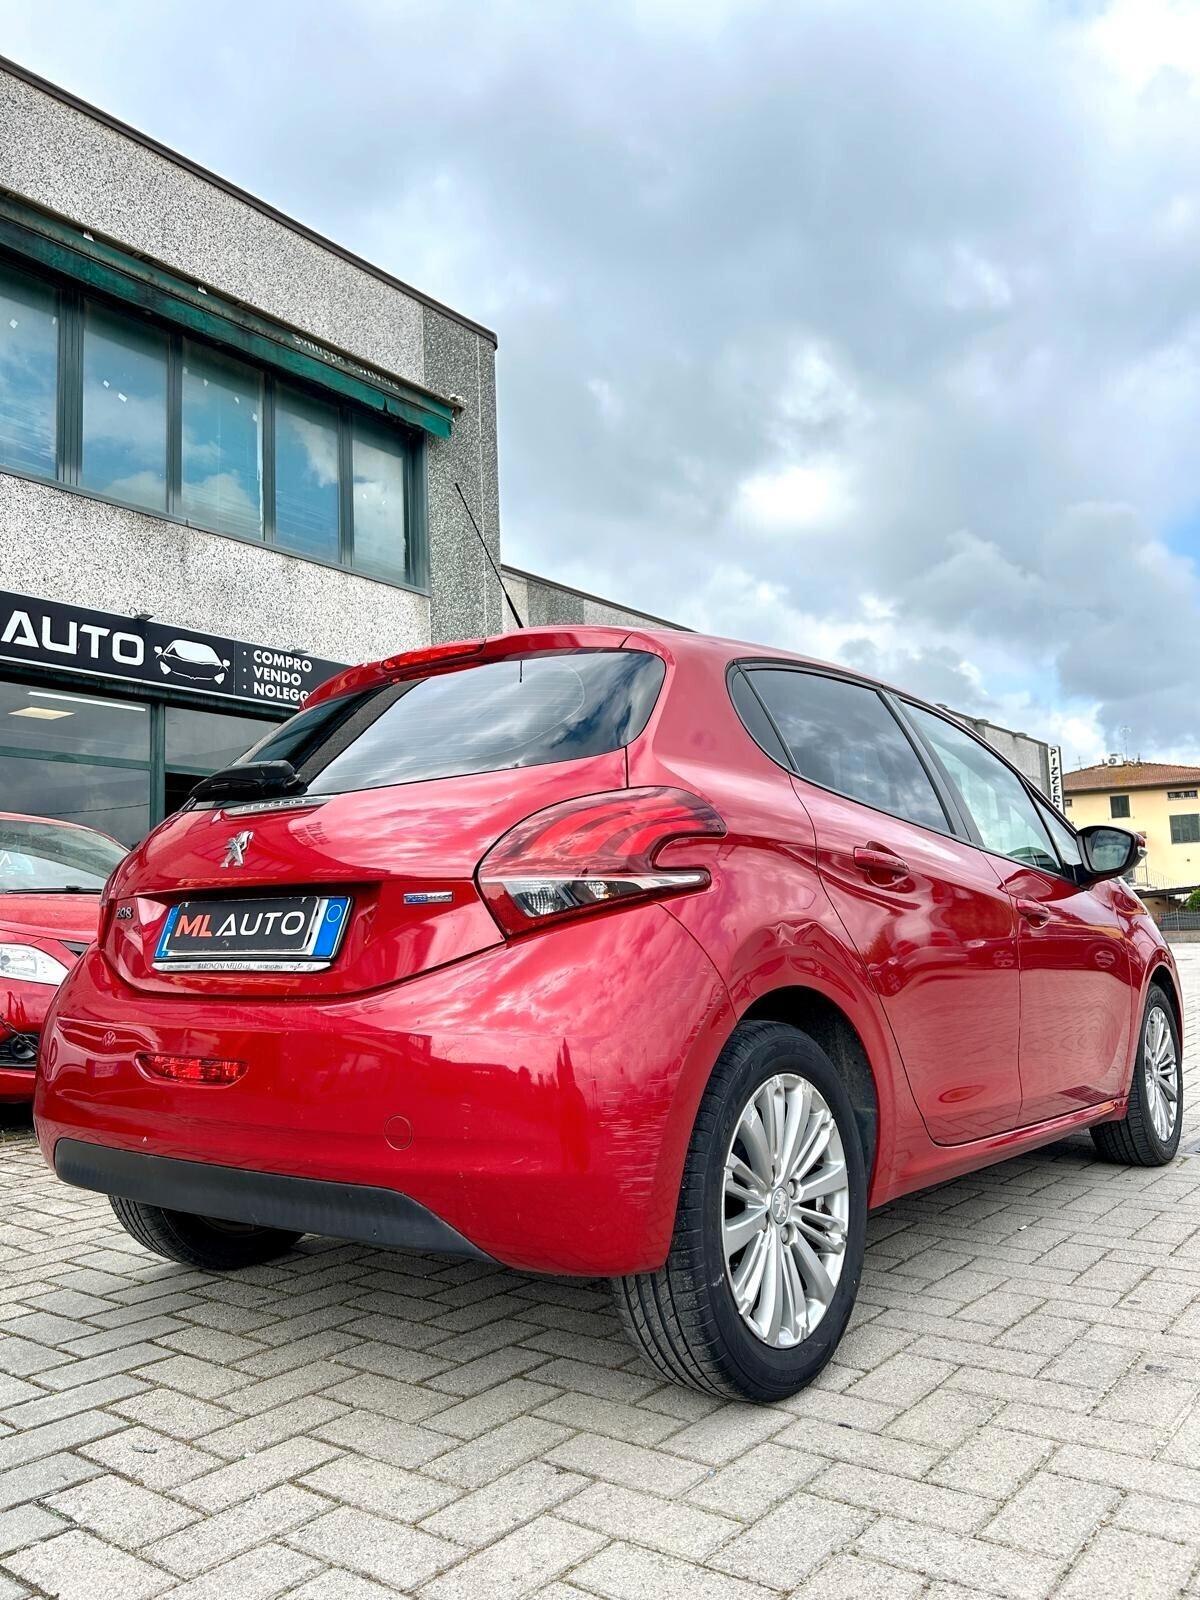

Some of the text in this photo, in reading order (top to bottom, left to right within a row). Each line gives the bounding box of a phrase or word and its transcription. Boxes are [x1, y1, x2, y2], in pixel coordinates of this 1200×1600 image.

[0, 609, 145, 666] AUTO
[253, 650, 313, 673] COMPRO
[252, 665, 302, 686] VENDO
[253, 681, 310, 702] NOLEGG
[175, 911, 306, 937] ML AUTO
